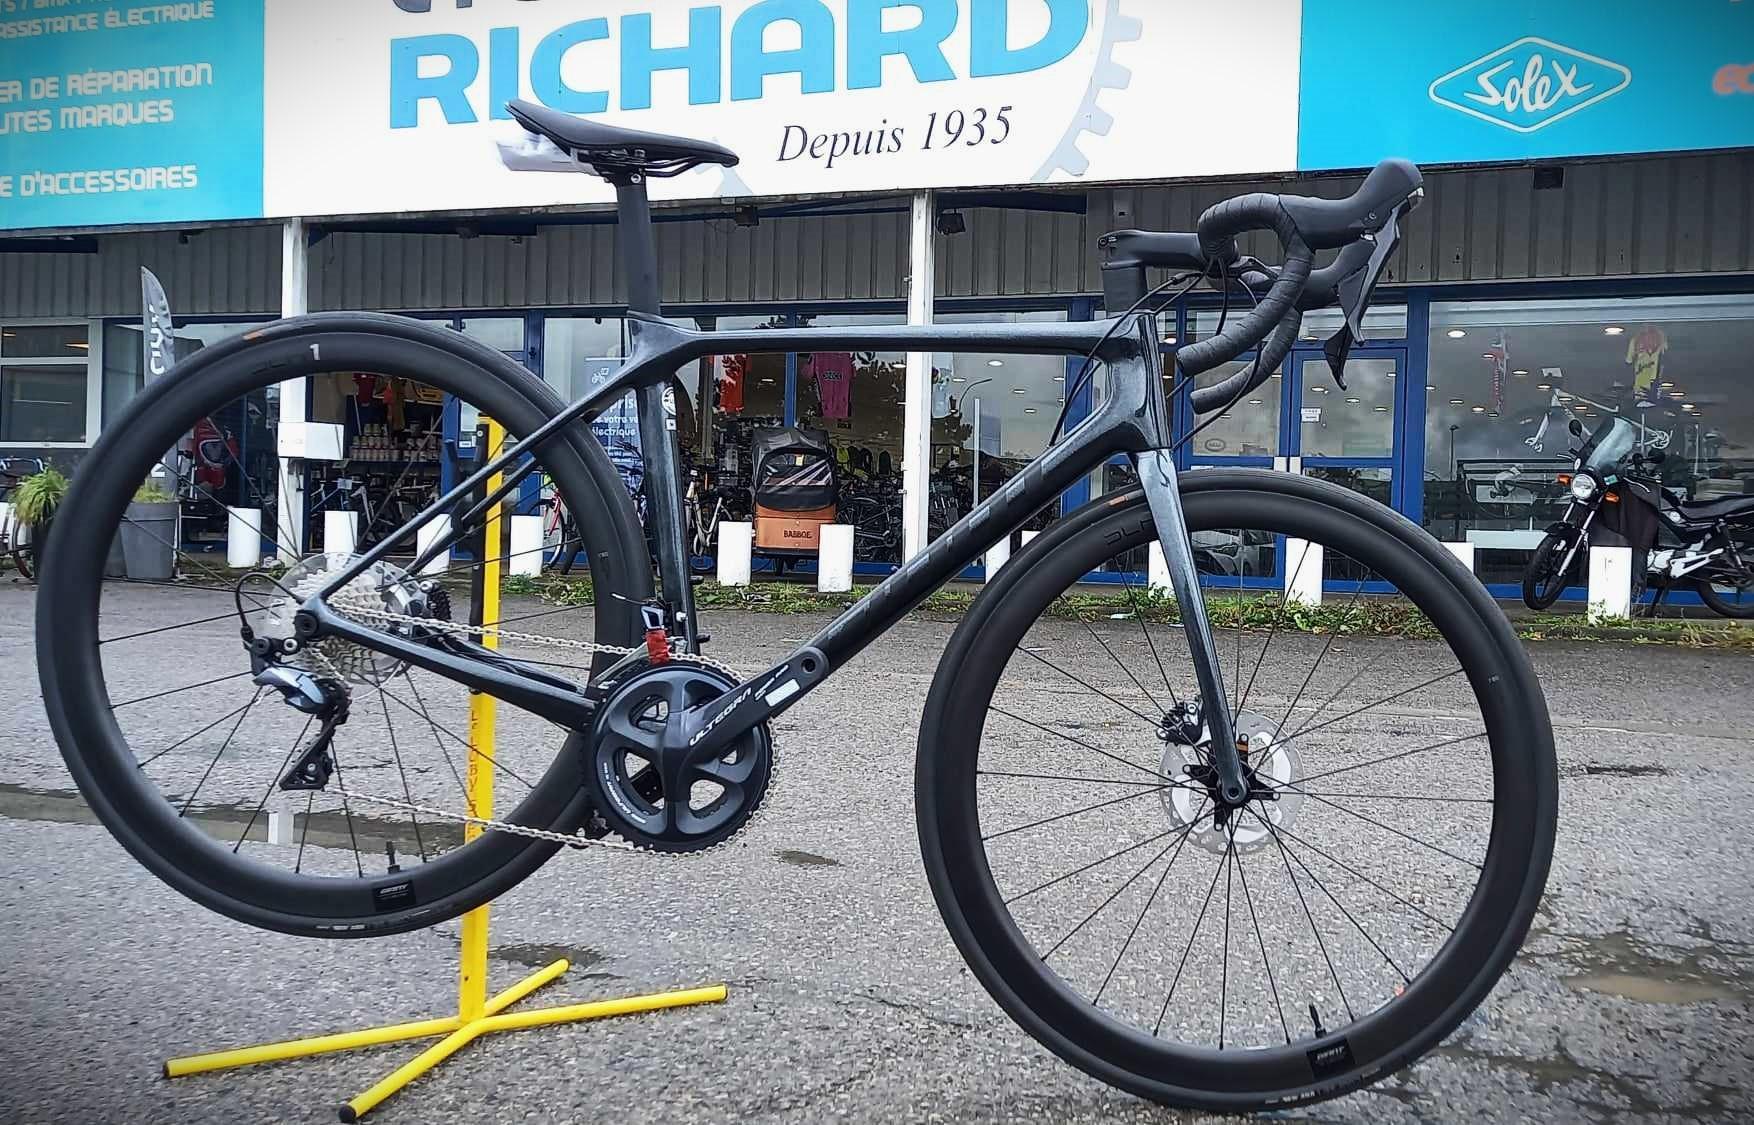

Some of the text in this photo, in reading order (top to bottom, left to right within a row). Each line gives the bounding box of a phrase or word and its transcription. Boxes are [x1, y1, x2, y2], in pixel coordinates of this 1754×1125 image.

[104, 0, 214, 28] ÉLECTRIQUE
[30, 76, 59, 99] DE
[67, 62, 212, 97] RÉPARATION
[390, 0, 1089, 129] RICHARD
[1464, 54, 1594, 112] Solex
[60, 99, 174, 129] MARQUES
[776, 106, 1012, 168] Depuis 1935
[20, 164, 197, 196] D'ACCESSOIRES
[309, 343, 320, 361] 1
